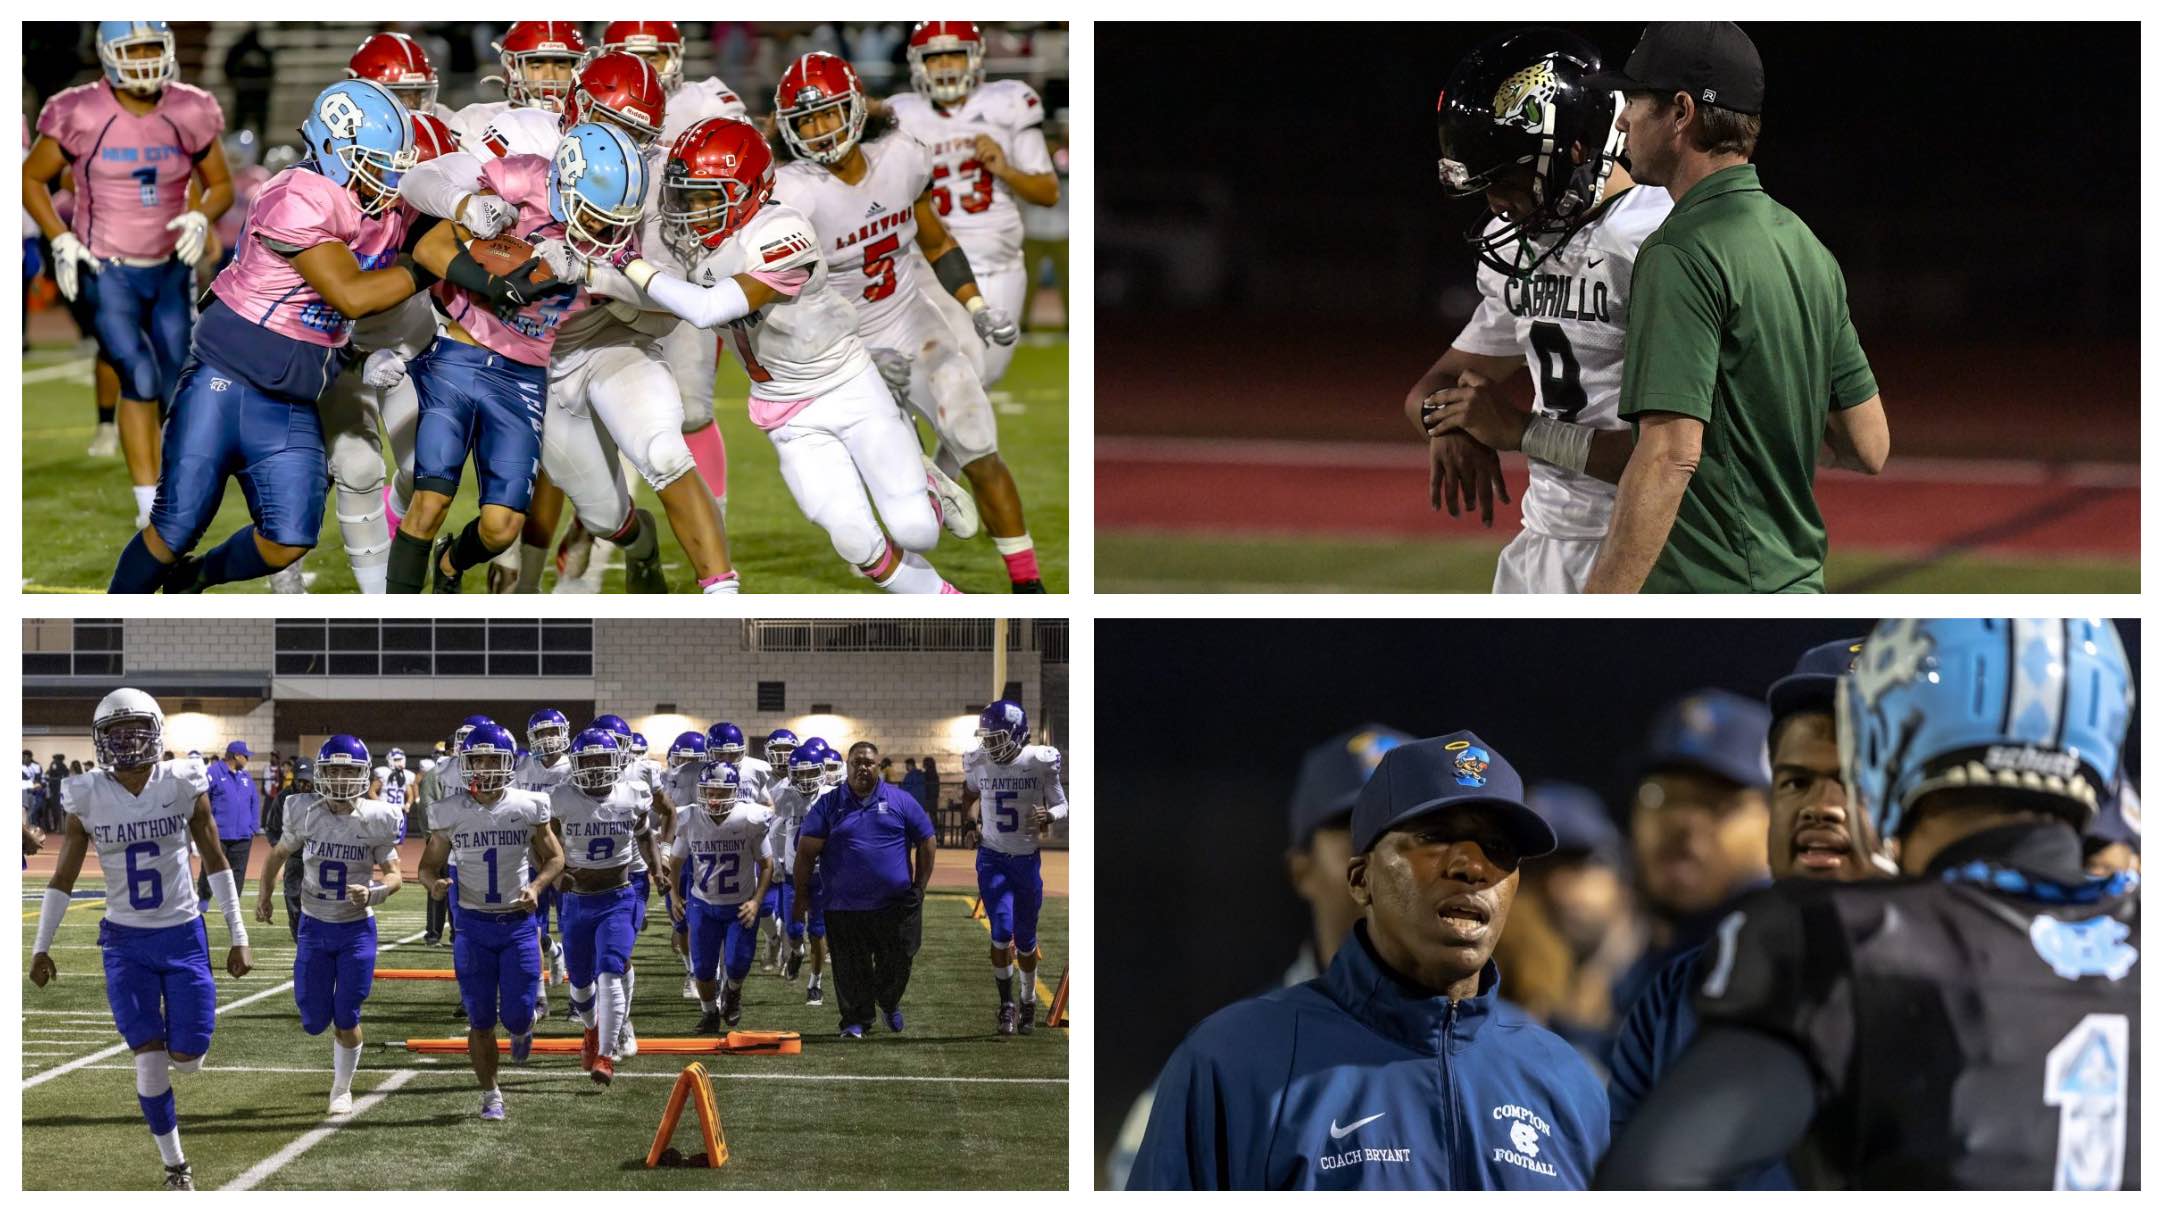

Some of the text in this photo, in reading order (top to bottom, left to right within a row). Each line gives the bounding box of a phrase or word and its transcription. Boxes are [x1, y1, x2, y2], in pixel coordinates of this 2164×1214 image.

[863, 231, 897, 303] 5
[1504, 274, 1610, 323] CABRILLO
[992, 777, 1037, 790] ANTHONY
[566, 822, 582, 836] ST.
[994, 791, 1019, 832] 5
[94, 825, 114, 844] ST.
[455, 829, 528, 848] ST. ANTHONY
[705, 838, 746, 852] ANTHONY
[125, 841, 164, 910] 6
[319, 860, 347, 901] 9
[482, 847, 502, 904] 1
[695, 852, 740, 895] 72
[1493, 1104, 1551, 1137] COMPTON
[2043, 1013, 2130, 1191] 1
[1320, 1148, 1411, 1170] COACH BRYANT
[1493, 1148, 1557, 1177] FOOTBALL
